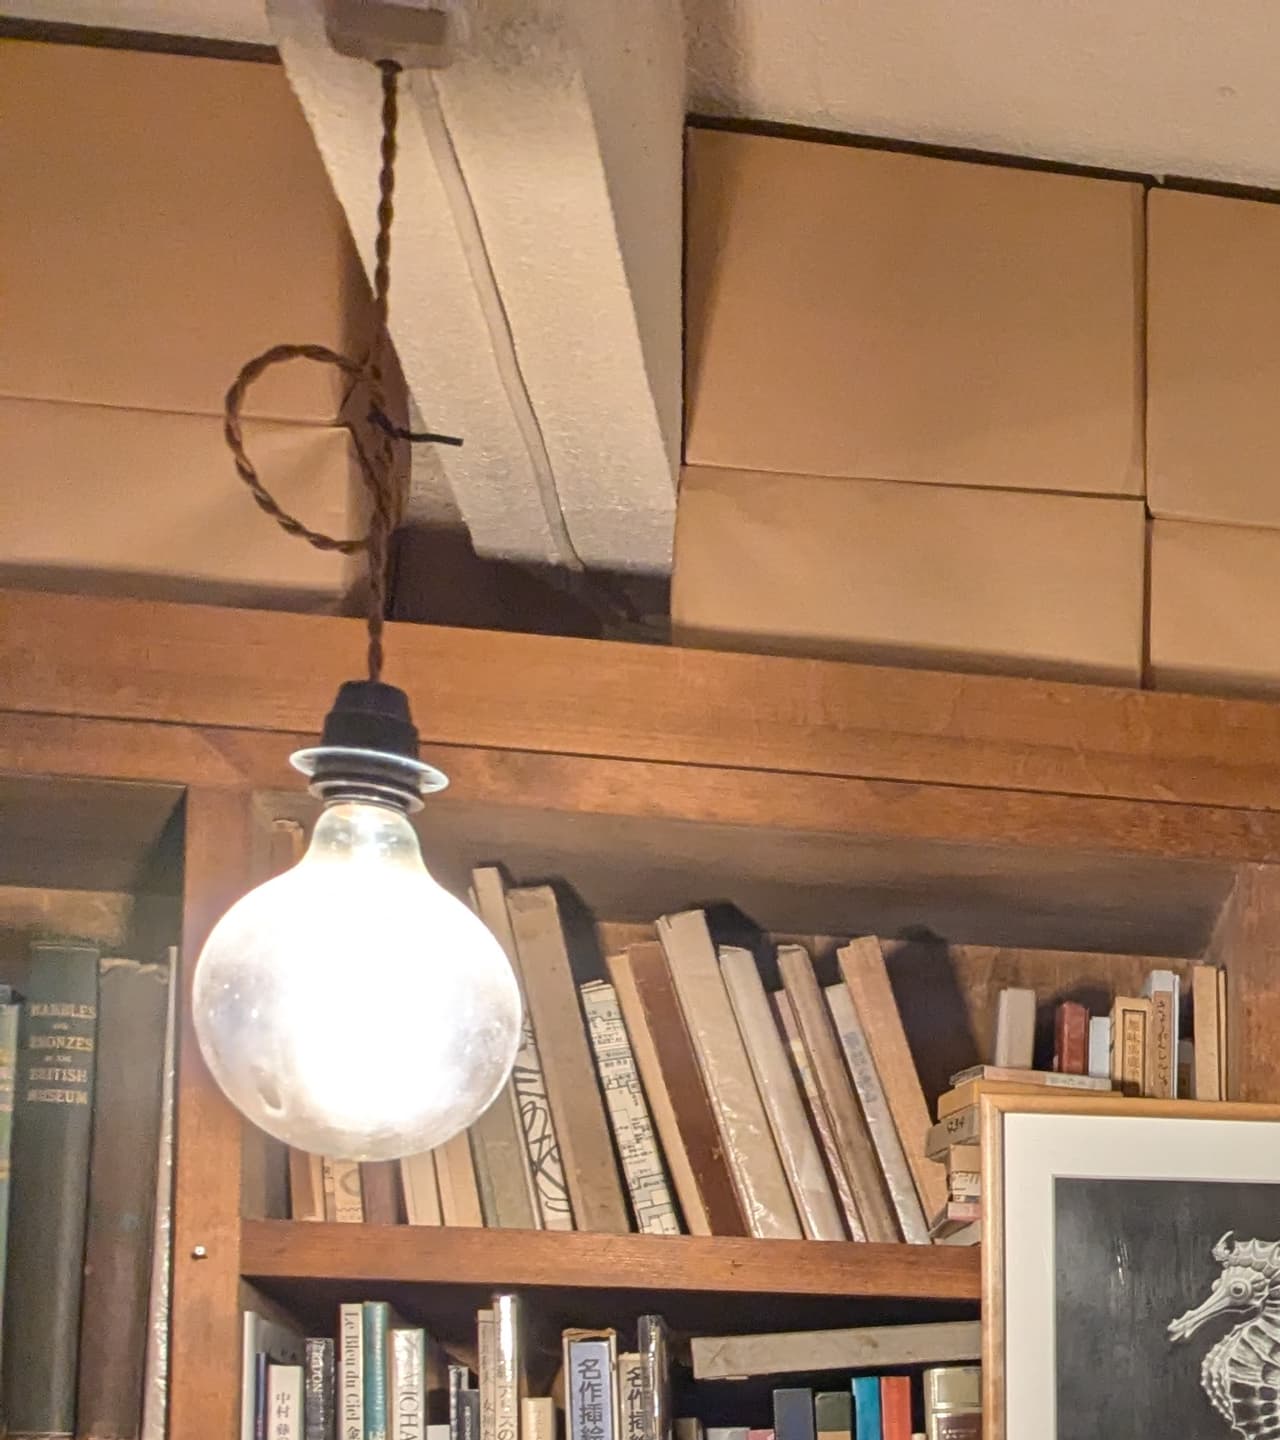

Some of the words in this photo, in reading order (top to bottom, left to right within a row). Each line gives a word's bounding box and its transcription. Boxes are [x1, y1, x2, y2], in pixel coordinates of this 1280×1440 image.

[30, 1003, 96, 1019] MARBLES
[29, 1035, 94, 1052] BRONZES
[29, 1068, 87, 1083] BRITISH
[27, 1089, 88, 1105] MUSEUM
[345, 1312, 359, 1330] Le
[345, 1335, 360, 1367] Bleu
[346, 1370, 360, 1388] du
[346, 1393, 361, 1422] Ciel
